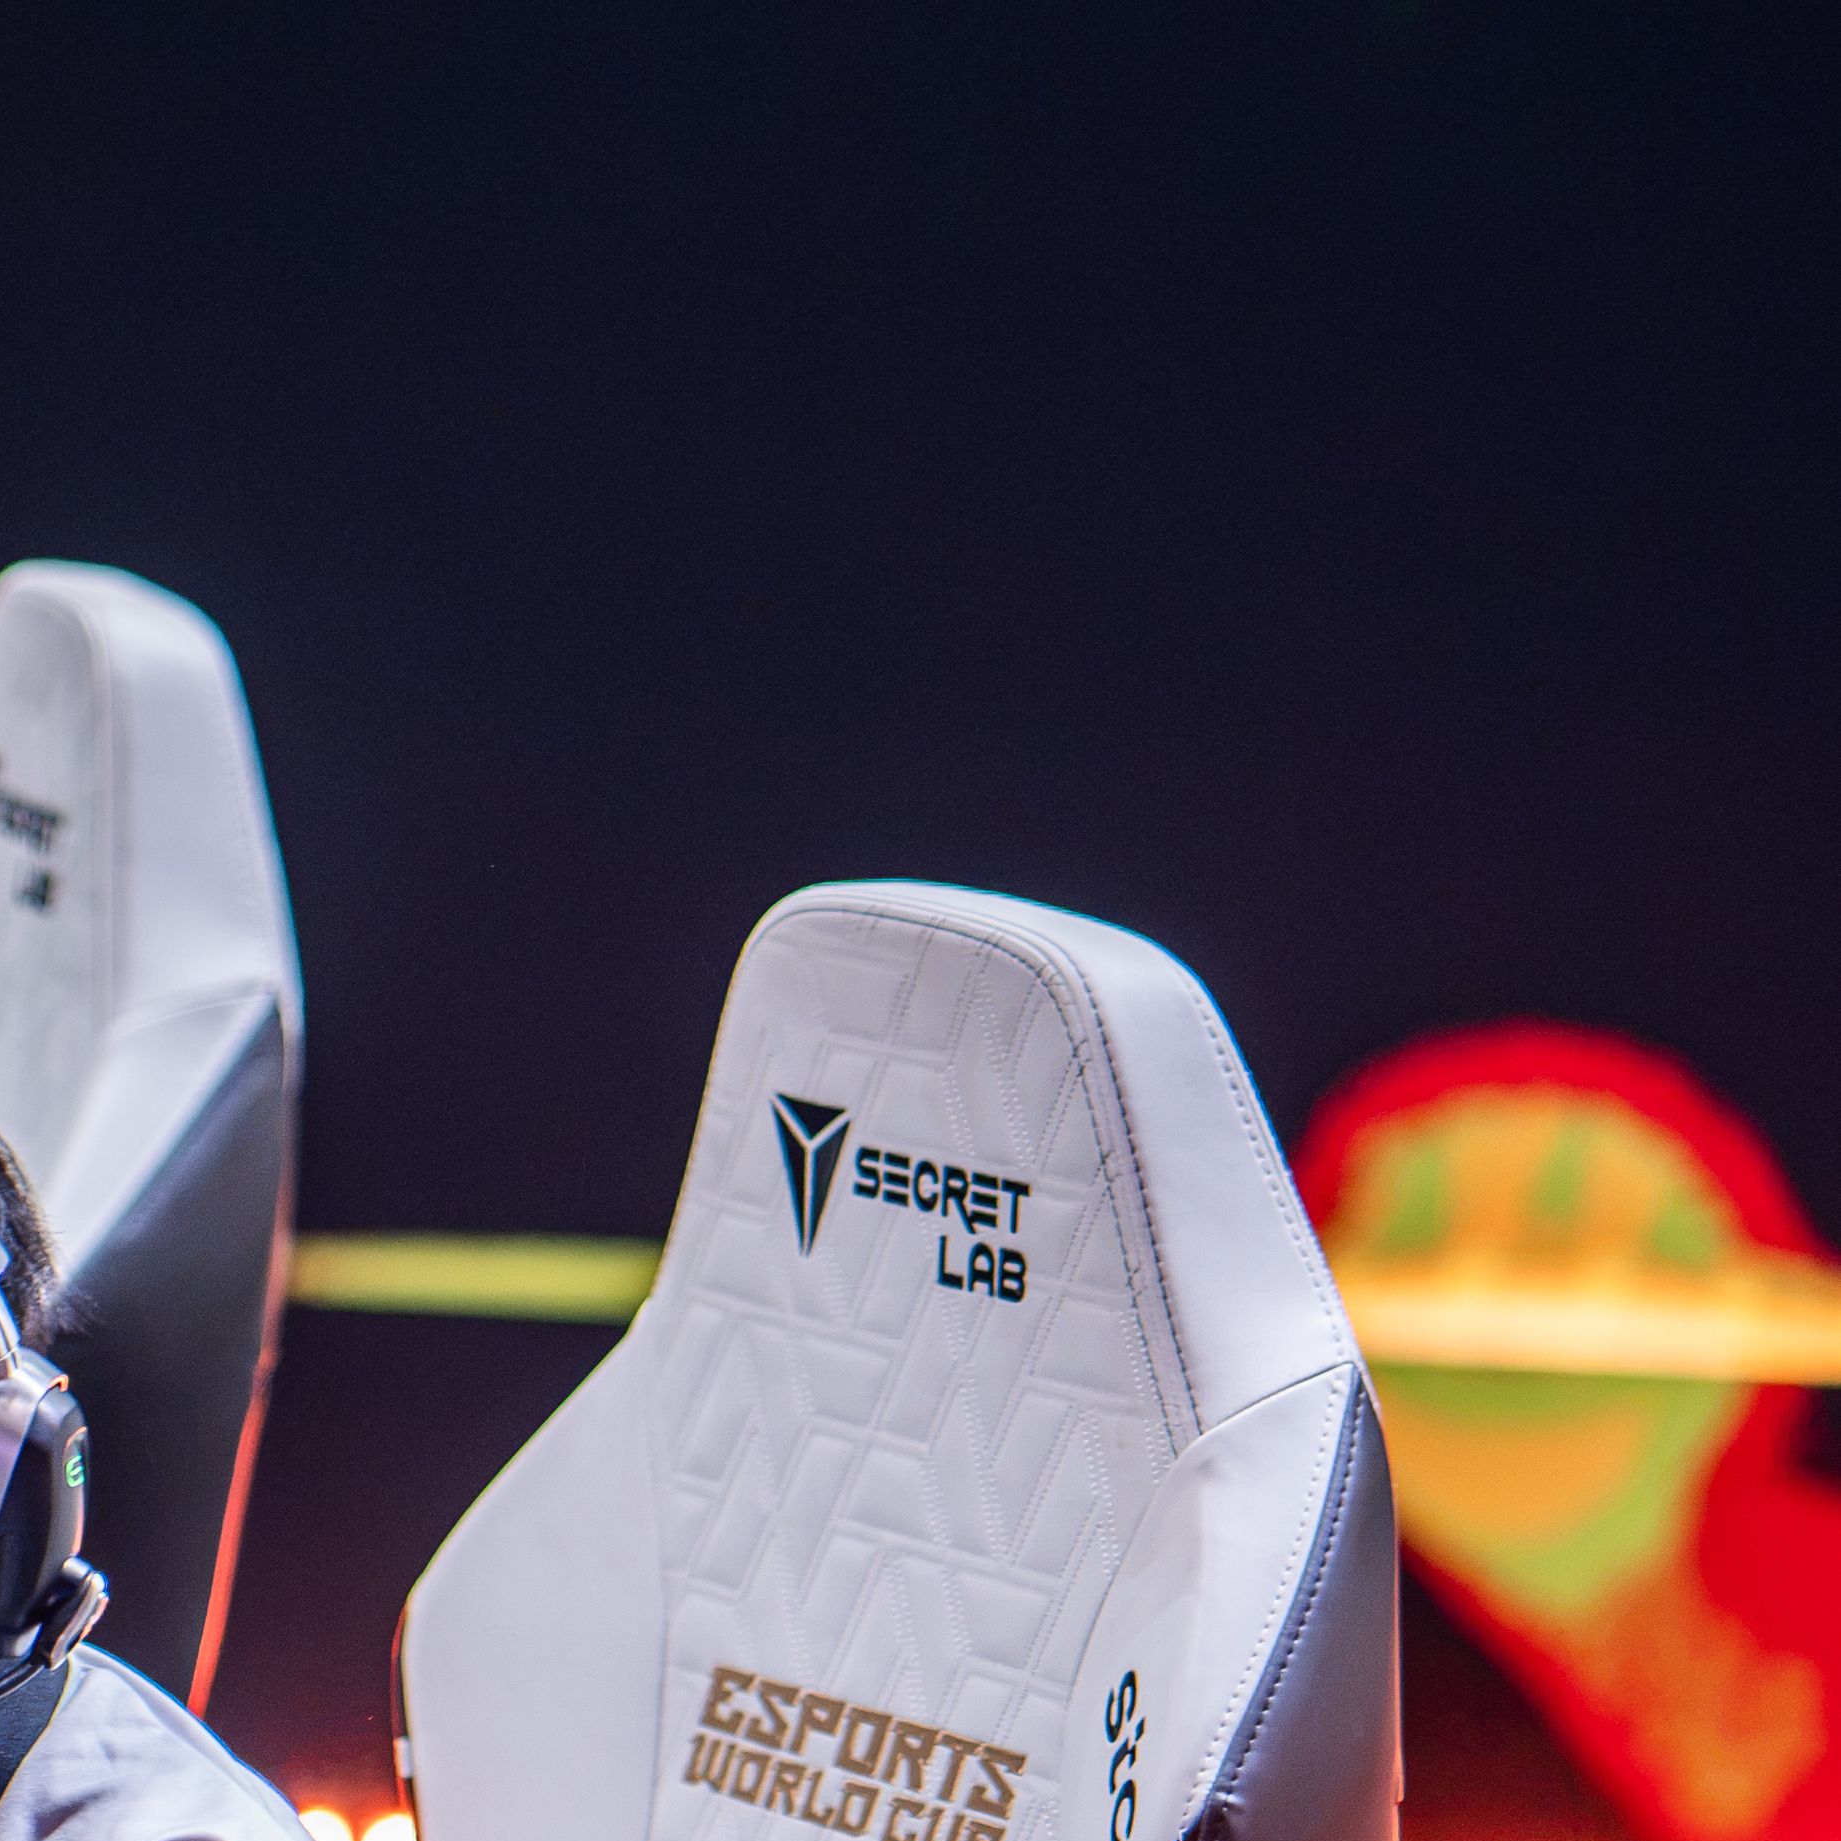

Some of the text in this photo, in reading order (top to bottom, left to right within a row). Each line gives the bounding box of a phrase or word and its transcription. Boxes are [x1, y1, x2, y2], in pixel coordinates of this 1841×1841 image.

[853, 1146, 1032, 1234] SECRET
[937, 1235, 1027, 1303] LAB
[683, 1733, 881, 1838] WORLD
[700, 1664, 1027, 1820] ESPORTS
